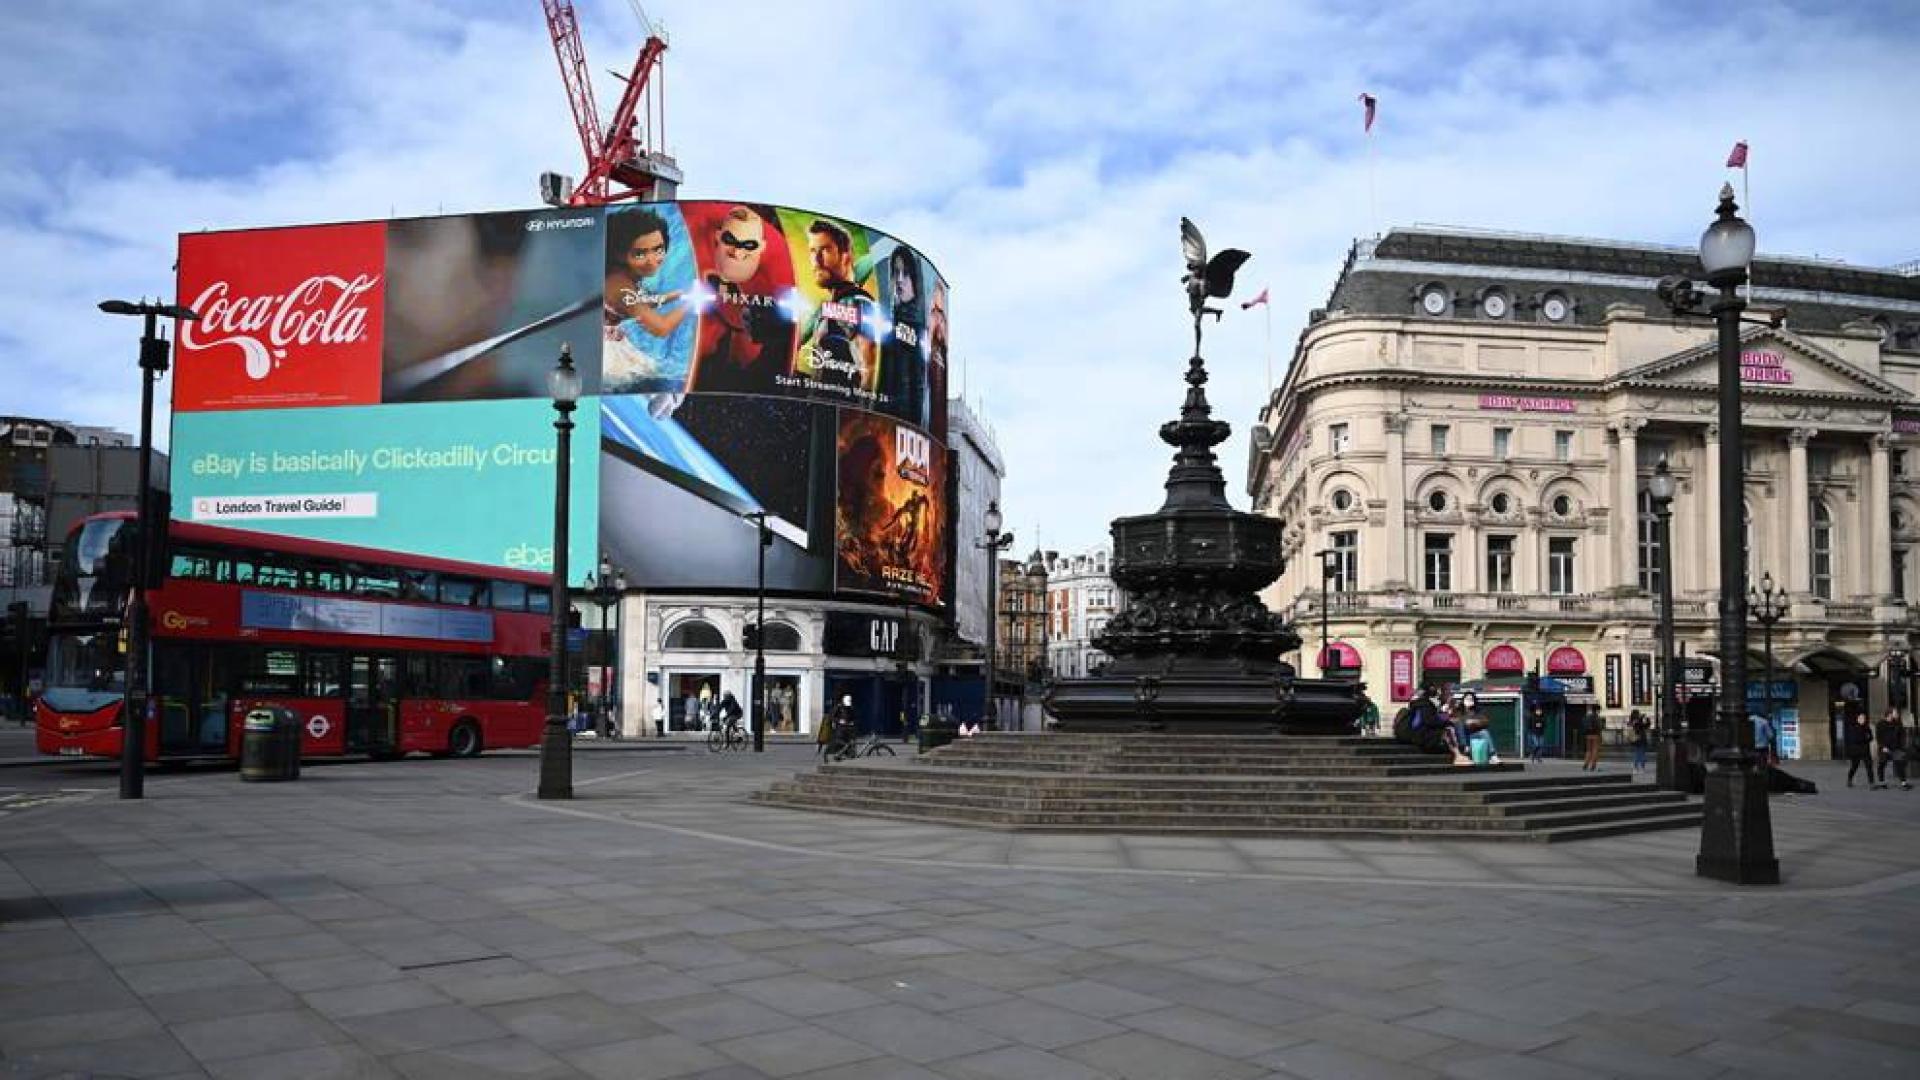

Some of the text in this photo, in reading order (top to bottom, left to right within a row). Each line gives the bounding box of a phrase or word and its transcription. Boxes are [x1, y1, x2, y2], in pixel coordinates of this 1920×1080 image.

[546, 217, 595, 230] HYUNDAI
[181, 274, 380, 350] Coca-Cola
[722, 293, 773, 307] PIXAR
[821, 302, 858, 325] MARVEL
[191, 453, 245, 479] eBay
[250, 451, 267, 473] is
[272, 449, 368, 476] basically
[372, 445, 486, 471] Clickadilly
[216, 498, 342, 514] London Travel Guide
[503, 542, 572, 567] eba
[870, 619, 899, 652] GAP
